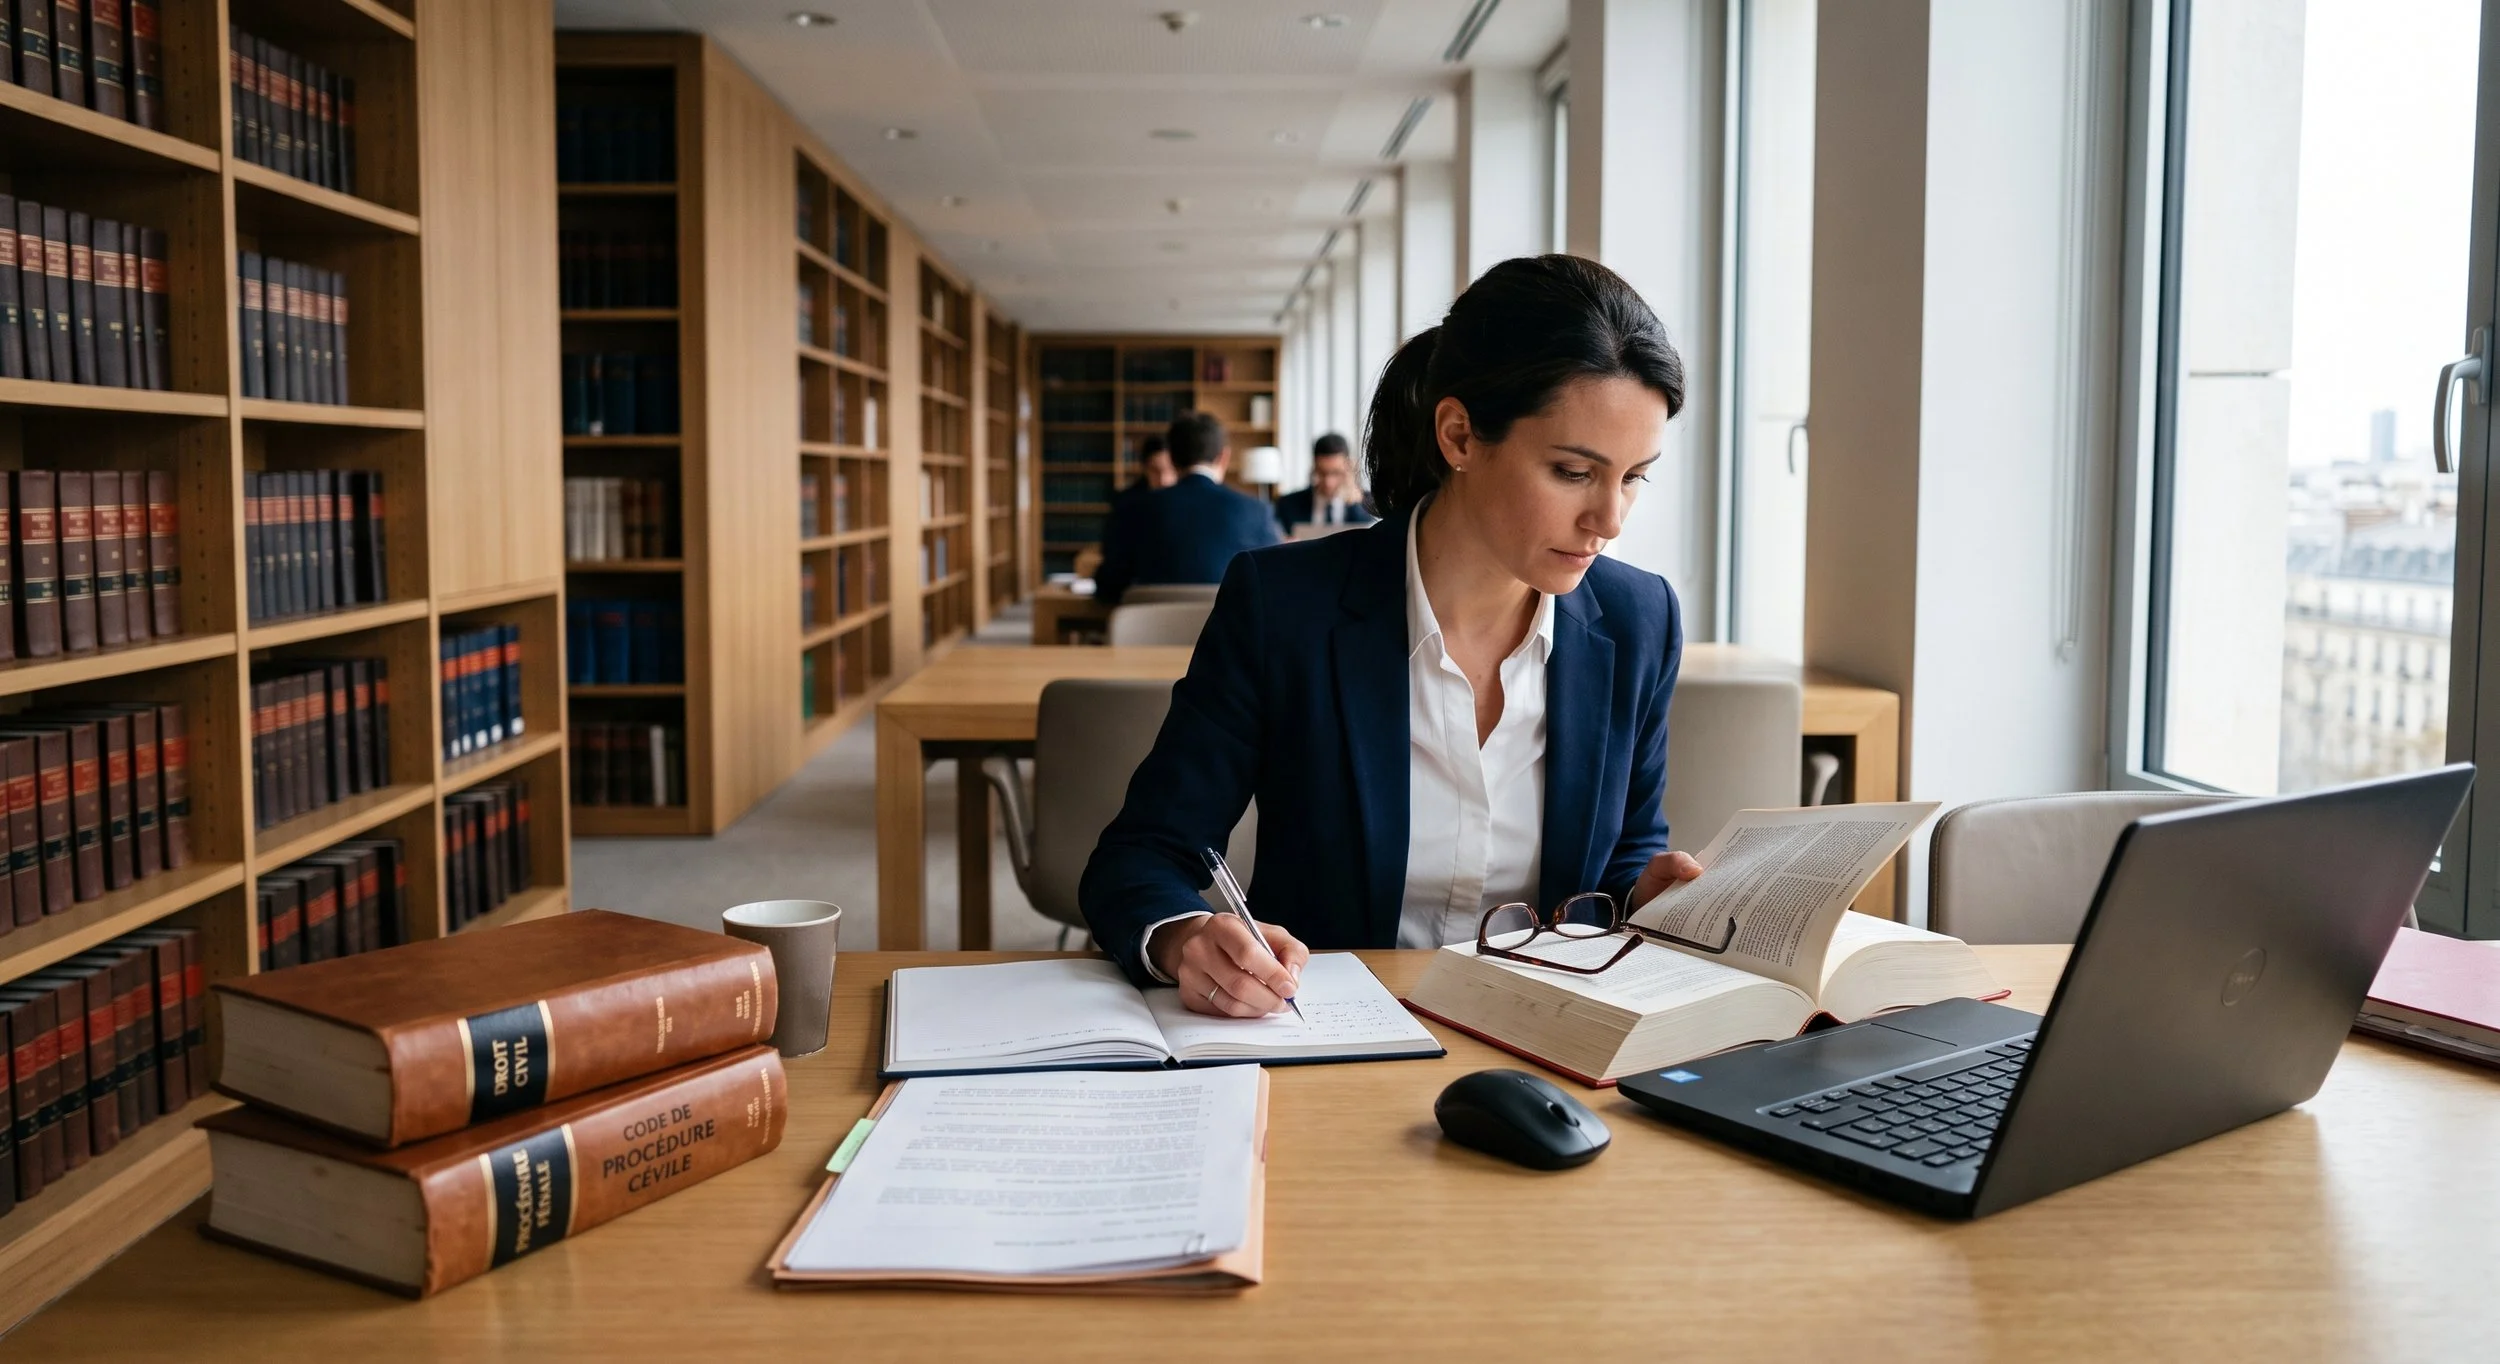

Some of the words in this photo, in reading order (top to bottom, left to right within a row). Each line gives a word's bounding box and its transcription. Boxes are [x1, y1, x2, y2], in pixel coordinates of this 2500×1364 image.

[492, 1039, 509, 1096] DROIT
[514, 1035, 529, 1087] CIVIL
[623, 1112, 667, 1141] CODE
[671, 1104, 692, 1124] DE
[603, 1119, 715, 1179] PROCÉDURE
[628, 1153, 692, 1193] CÉVILE
